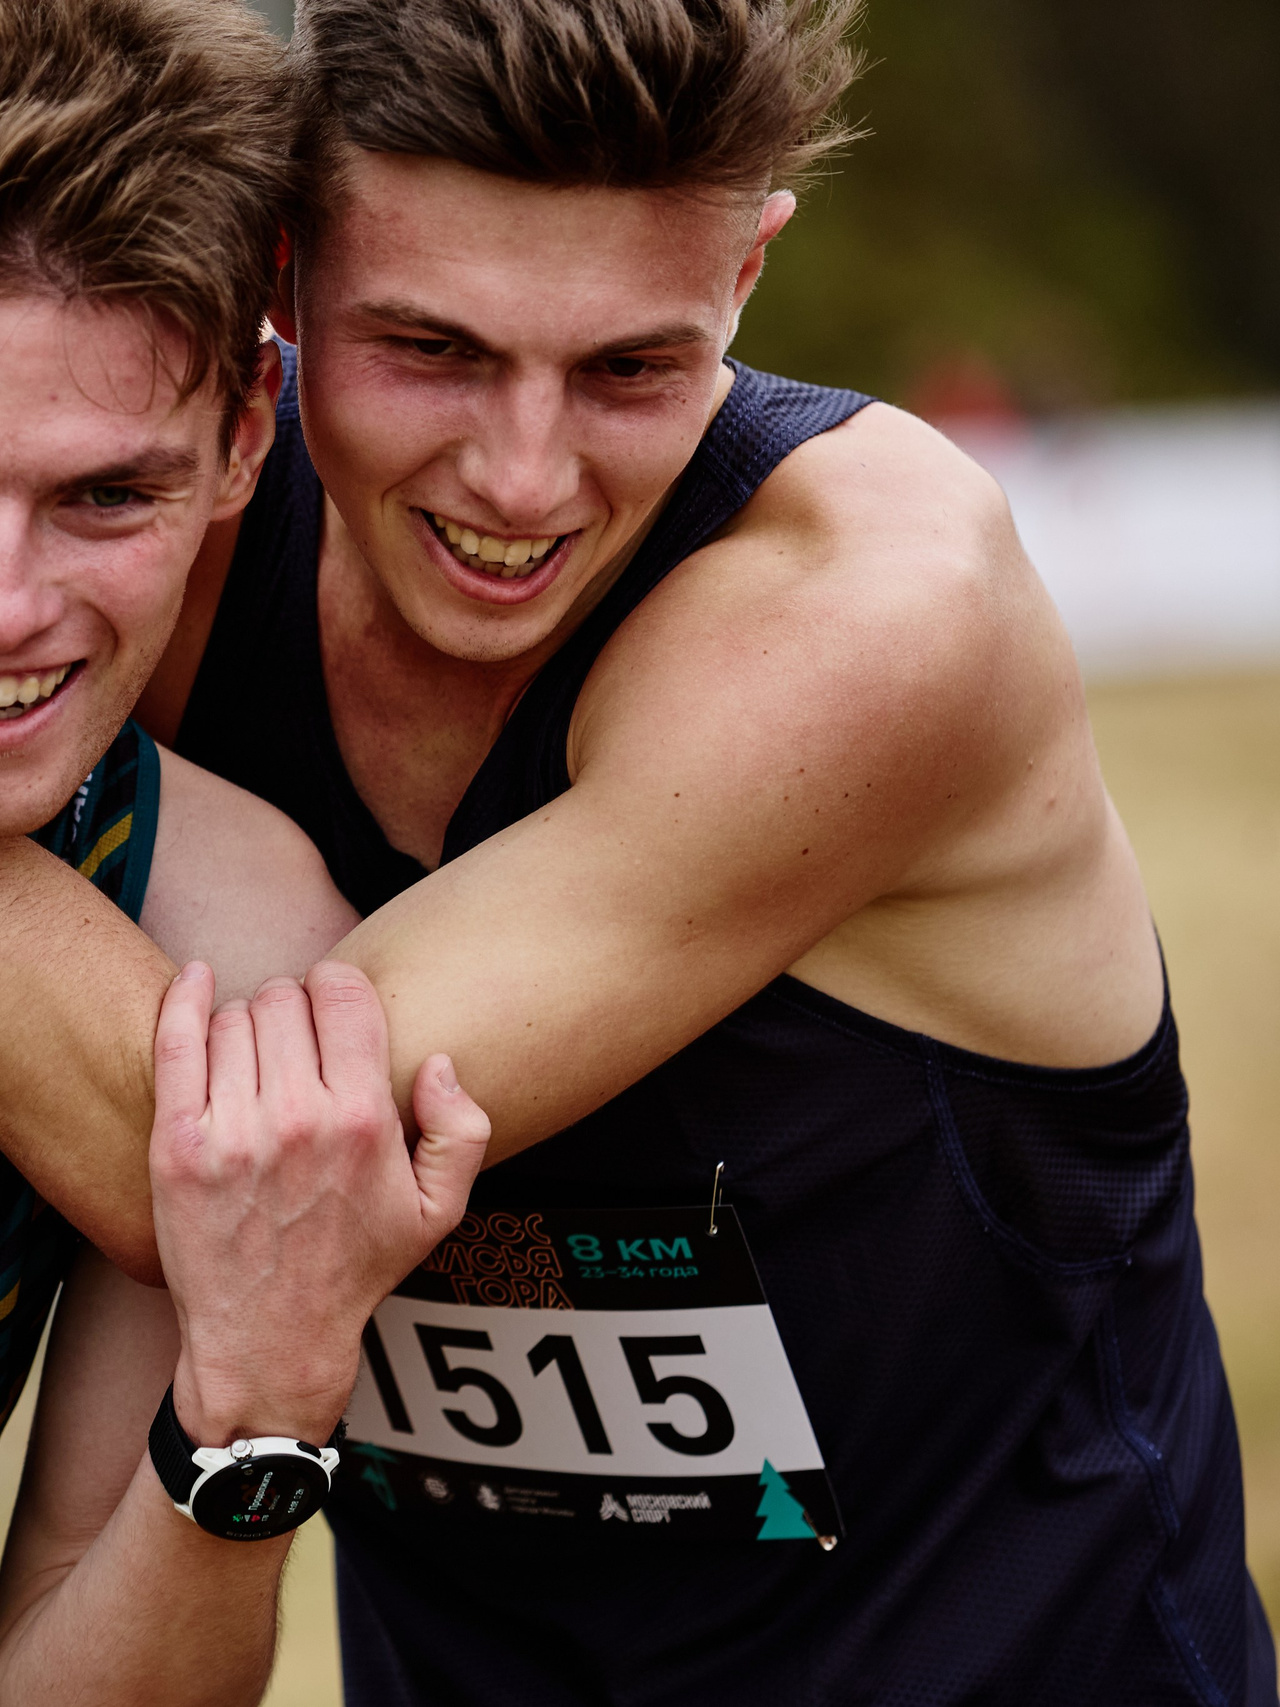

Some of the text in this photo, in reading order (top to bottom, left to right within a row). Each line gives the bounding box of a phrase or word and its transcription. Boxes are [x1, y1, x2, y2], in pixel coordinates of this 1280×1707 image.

[567, 1234, 694, 1261] 8 КМ
[649, 1265, 700, 1279] года
[450, 1275, 576, 1311] ГОРА
